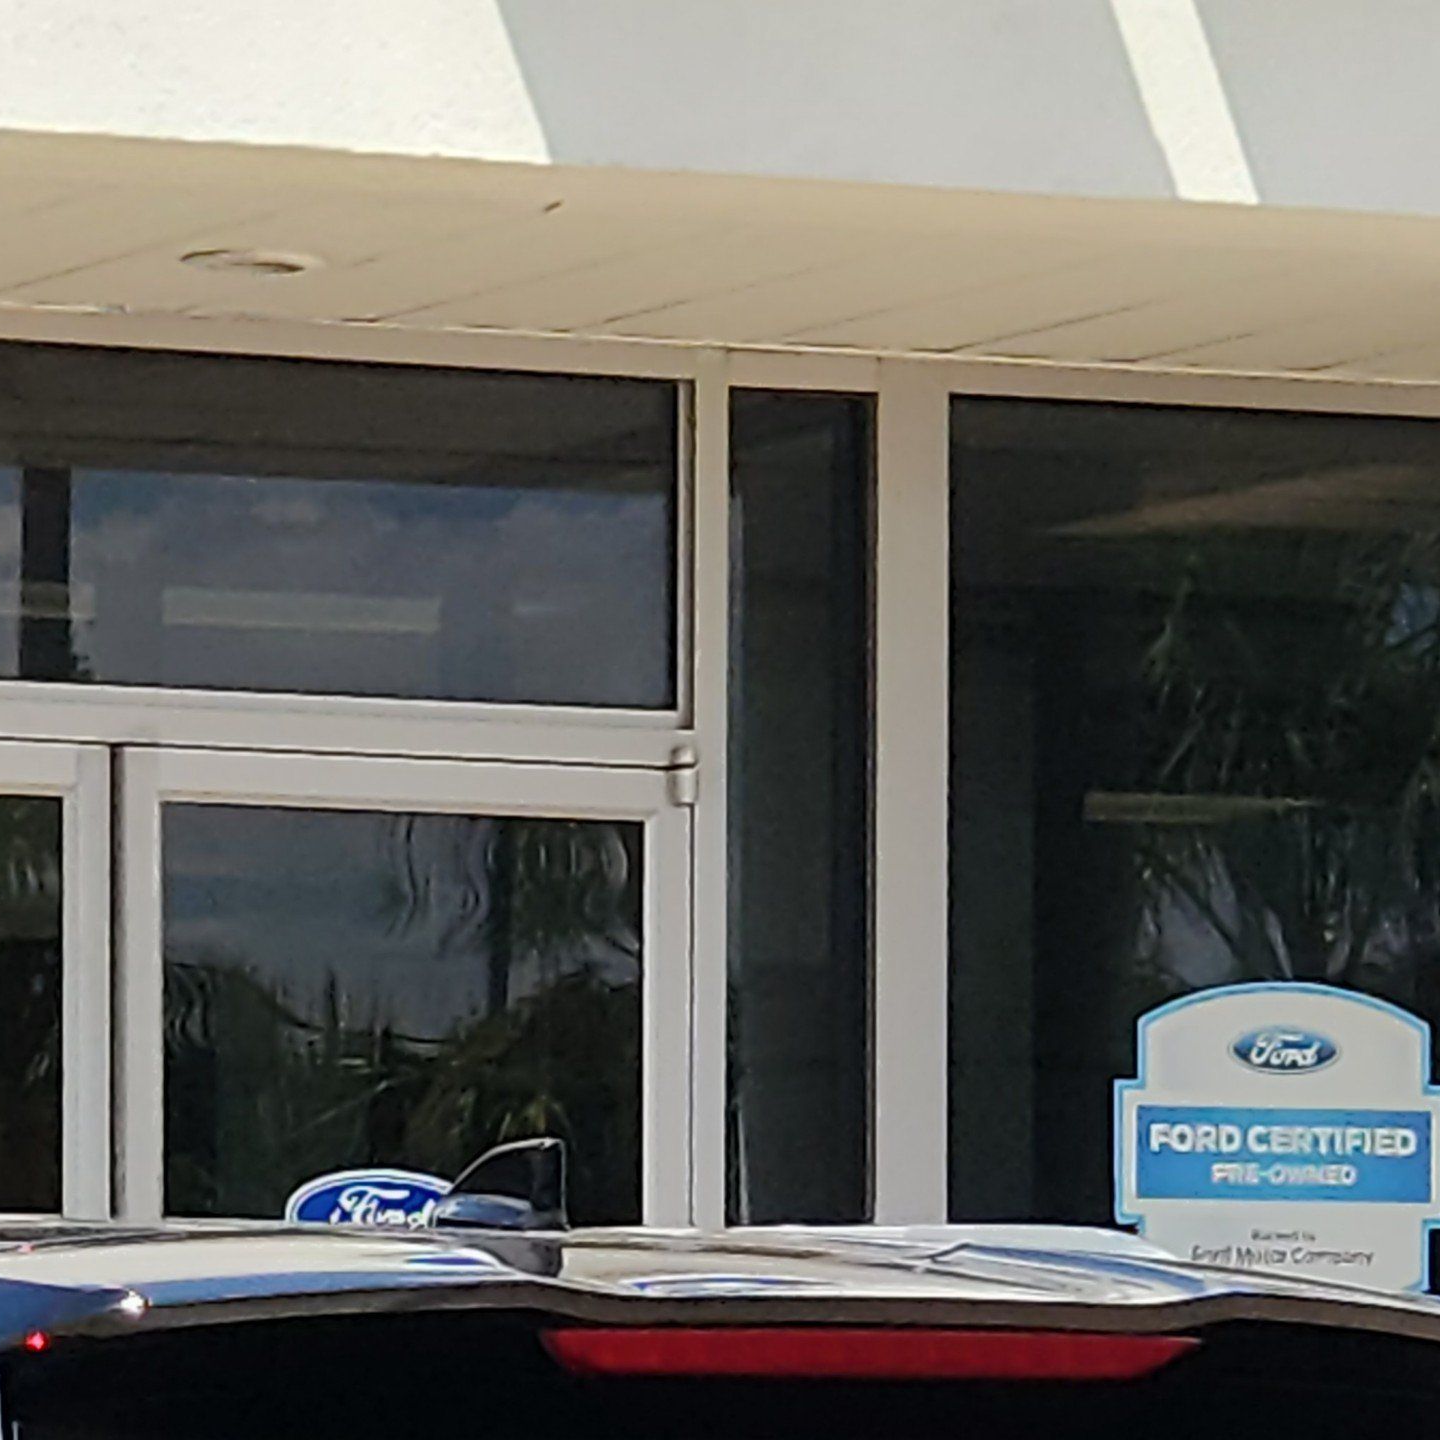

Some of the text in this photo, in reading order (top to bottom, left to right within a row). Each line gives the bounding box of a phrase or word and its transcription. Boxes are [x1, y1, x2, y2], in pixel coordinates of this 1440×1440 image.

[1249, 1033, 1321, 1066] Ford
[1149, 1123, 1417, 1158] FORD CERTIFIED
[328, 1185, 438, 1231] Ford
